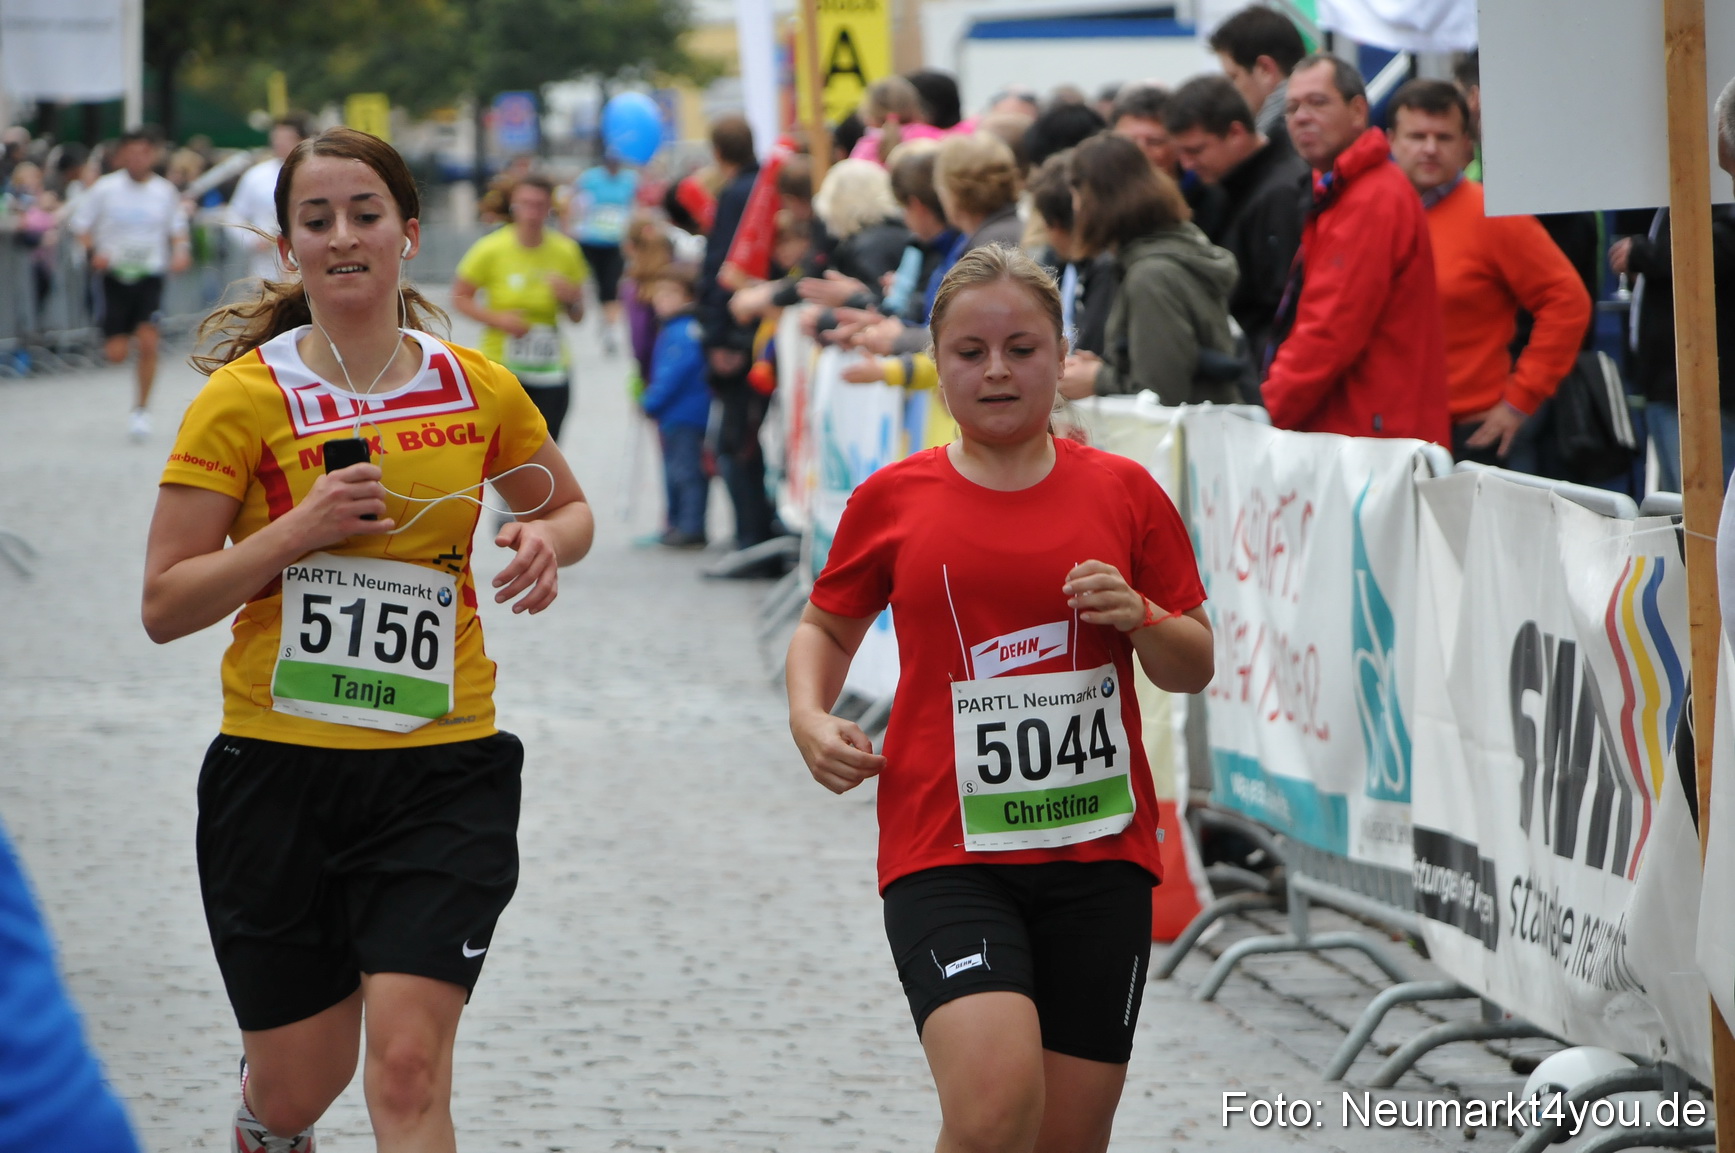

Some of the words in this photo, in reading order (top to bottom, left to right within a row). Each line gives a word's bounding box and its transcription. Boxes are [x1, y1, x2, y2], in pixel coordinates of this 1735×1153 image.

[823, 28, 869, 88] A
[298, 435, 388, 470] MX
[396, 422, 485, 451] BÖGL
[286, 566, 348, 586] PARTL
[353, 572, 433, 601] Neumarkt
[299, 592, 440, 671] 5156
[1000, 636, 1040, 663] DEHN
[331, 673, 397, 709] Tanja
[957, 695, 1019, 714] PARTL
[1023, 685, 1098, 708] Neumarkt
[976, 707, 1117, 785] 5044
[1003, 794, 1100, 825] Christina
